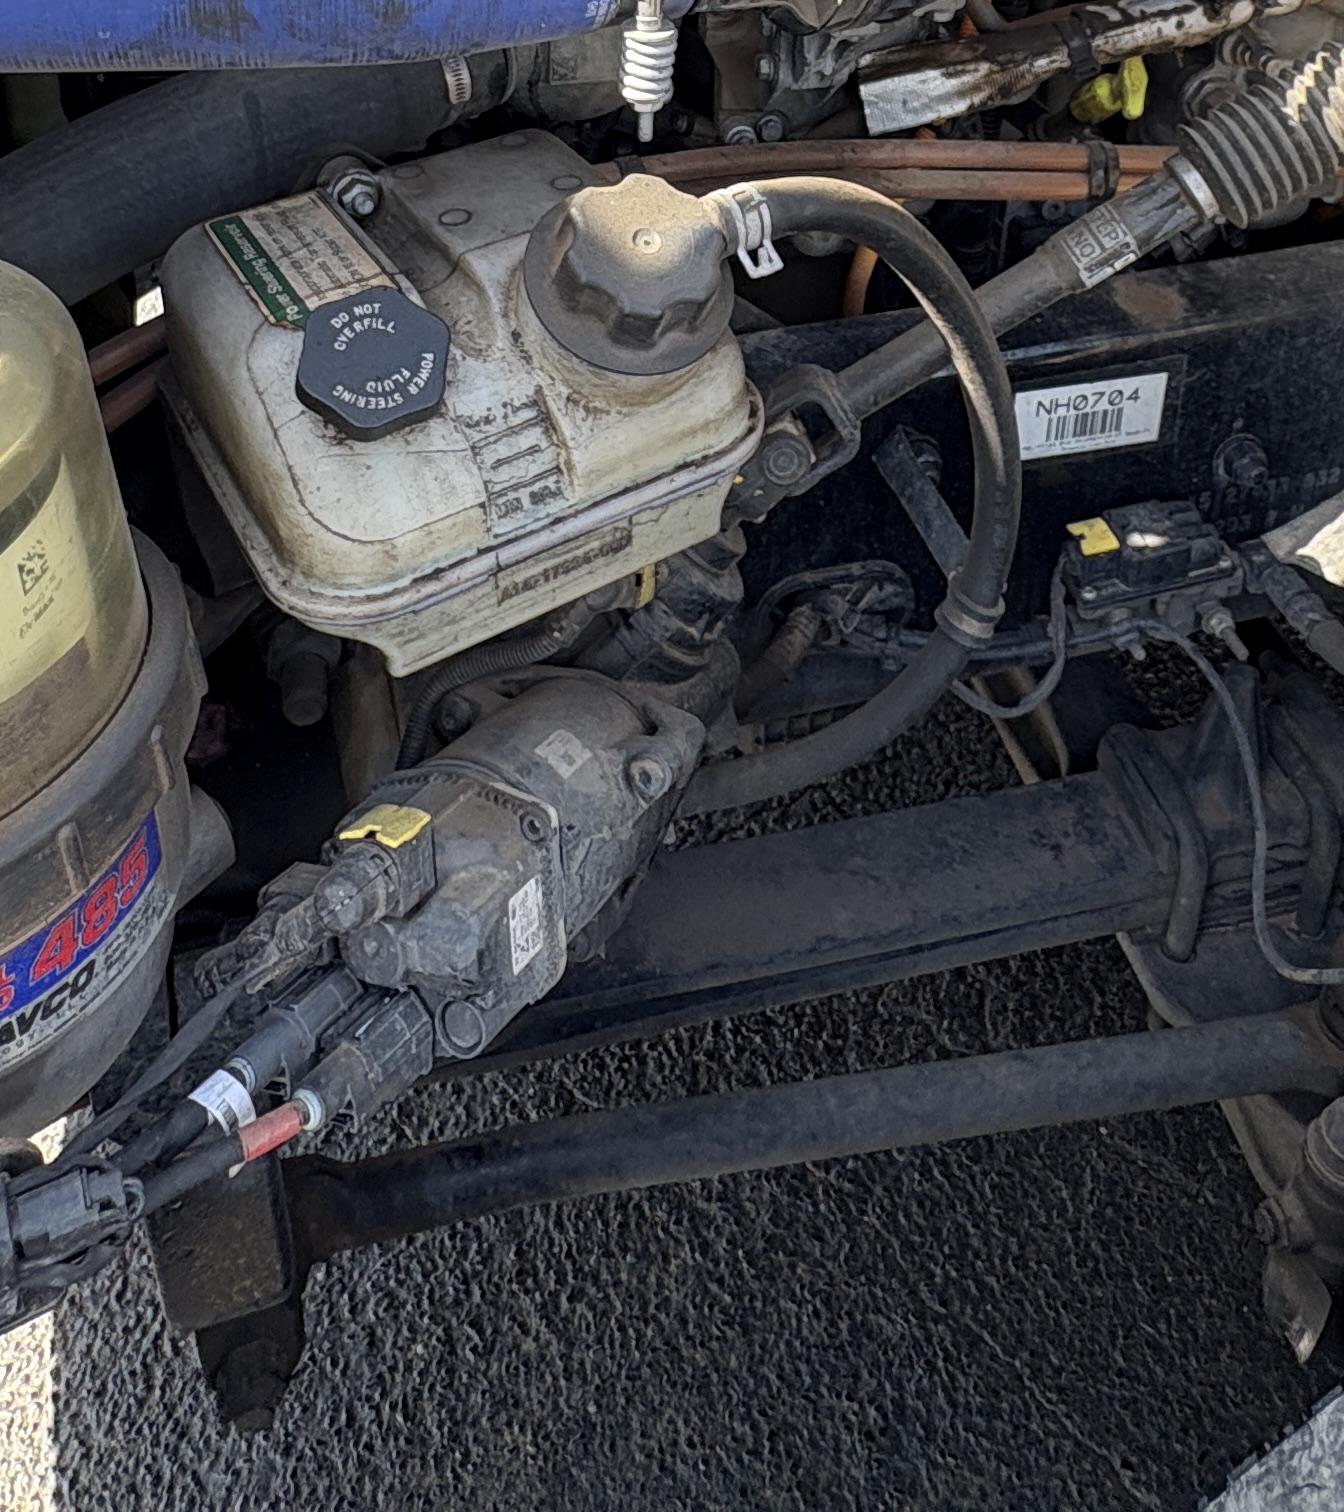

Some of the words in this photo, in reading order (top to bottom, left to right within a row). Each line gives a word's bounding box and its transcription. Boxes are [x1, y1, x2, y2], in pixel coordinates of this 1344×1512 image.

[220, 221, 257, 260] Reservoir
[248, 257, 283, 295] Steering
[275, 290, 303, 321] Power
[330, 311, 350, 329] DO
[354, 302, 382, 317] NOT
[334, 317, 396, 351] OVERFILL
[366, 367, 411, 393] FLUID
[407, 352, 434, 396] POWER
[332, 384, 404, 410] STEERING
[1036, 386, 1141, 418] NH0704
[28, 827, 149, 986] 485
